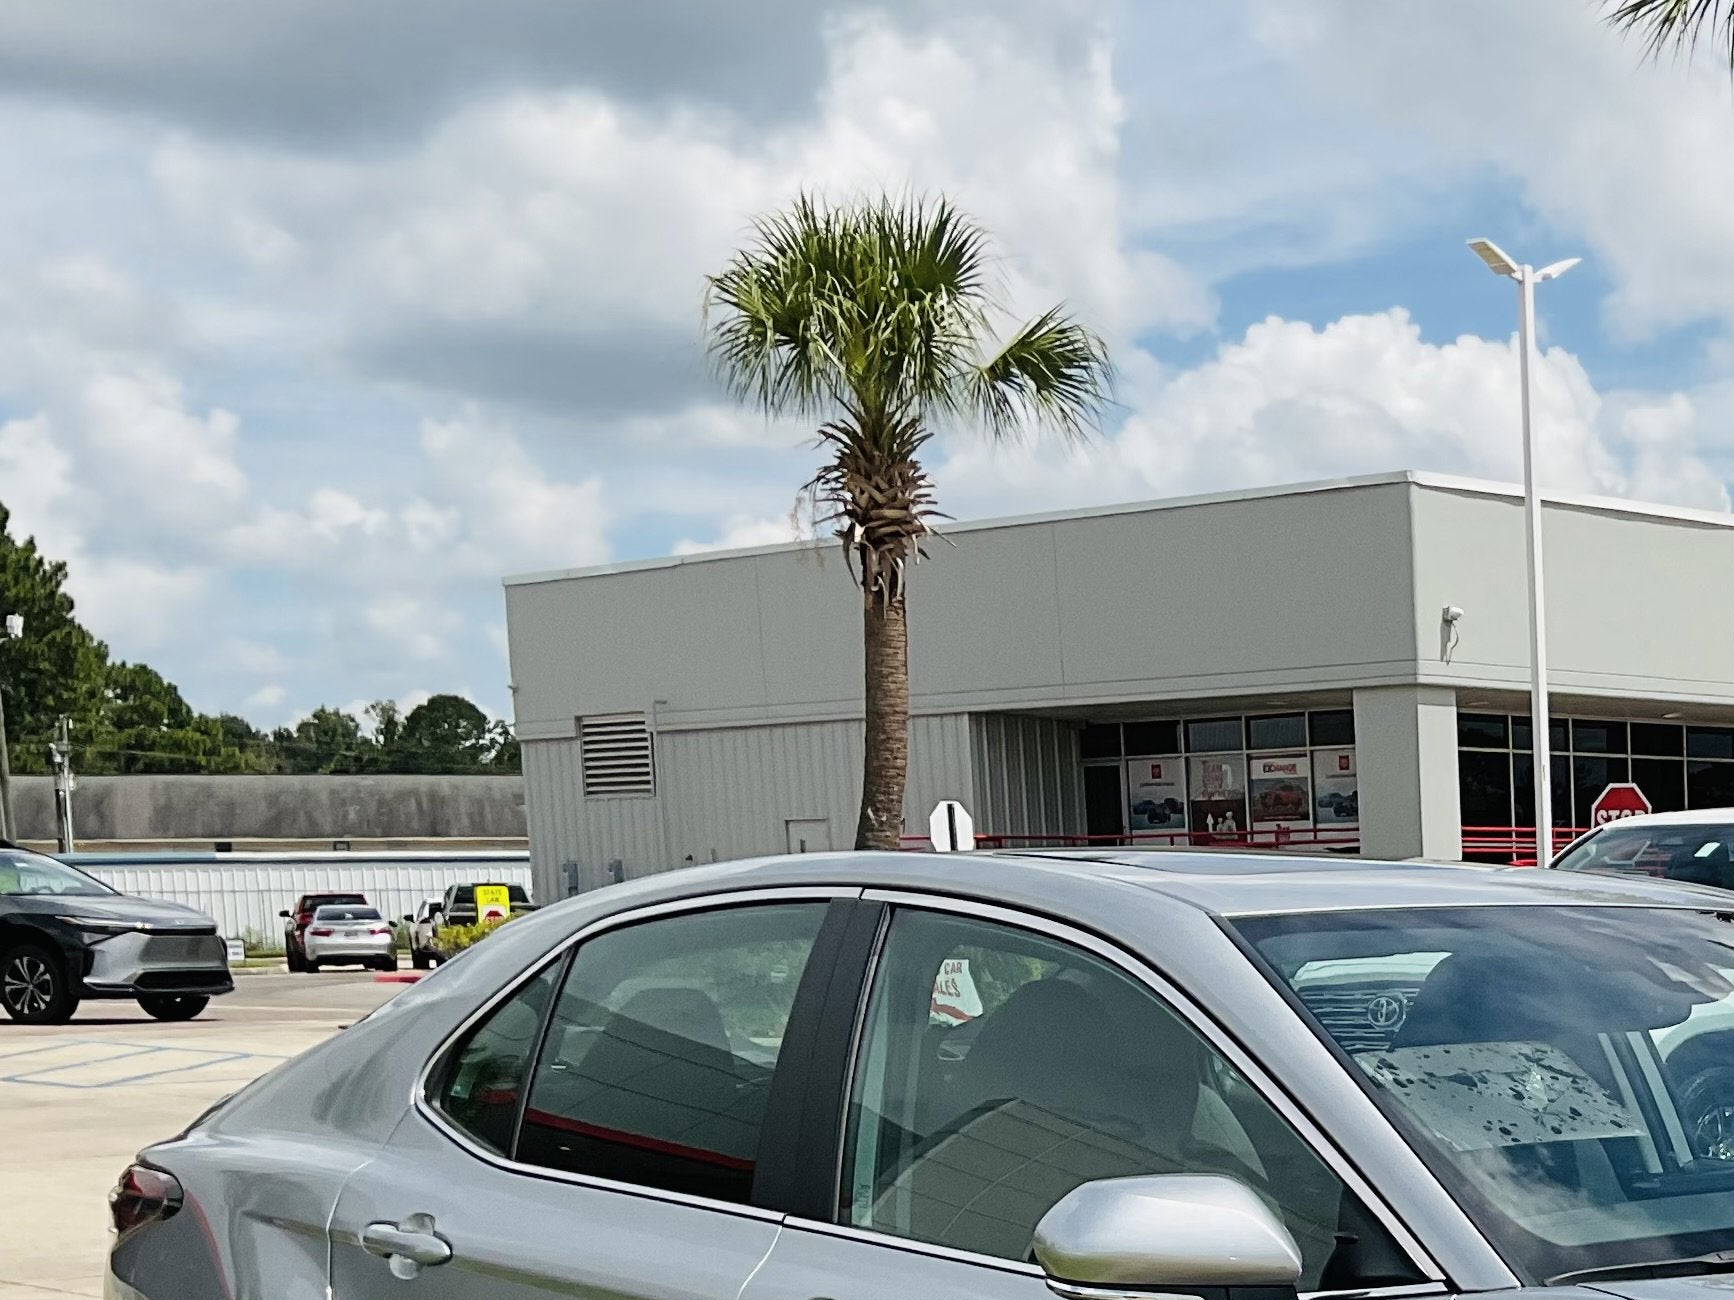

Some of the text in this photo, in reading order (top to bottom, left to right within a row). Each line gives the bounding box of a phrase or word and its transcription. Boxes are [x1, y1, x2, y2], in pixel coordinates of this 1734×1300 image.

[1597, 809, 1646, 825] ST
[944, 961, 963, 975] CAR
[933, 978, 961, 998] ALES
